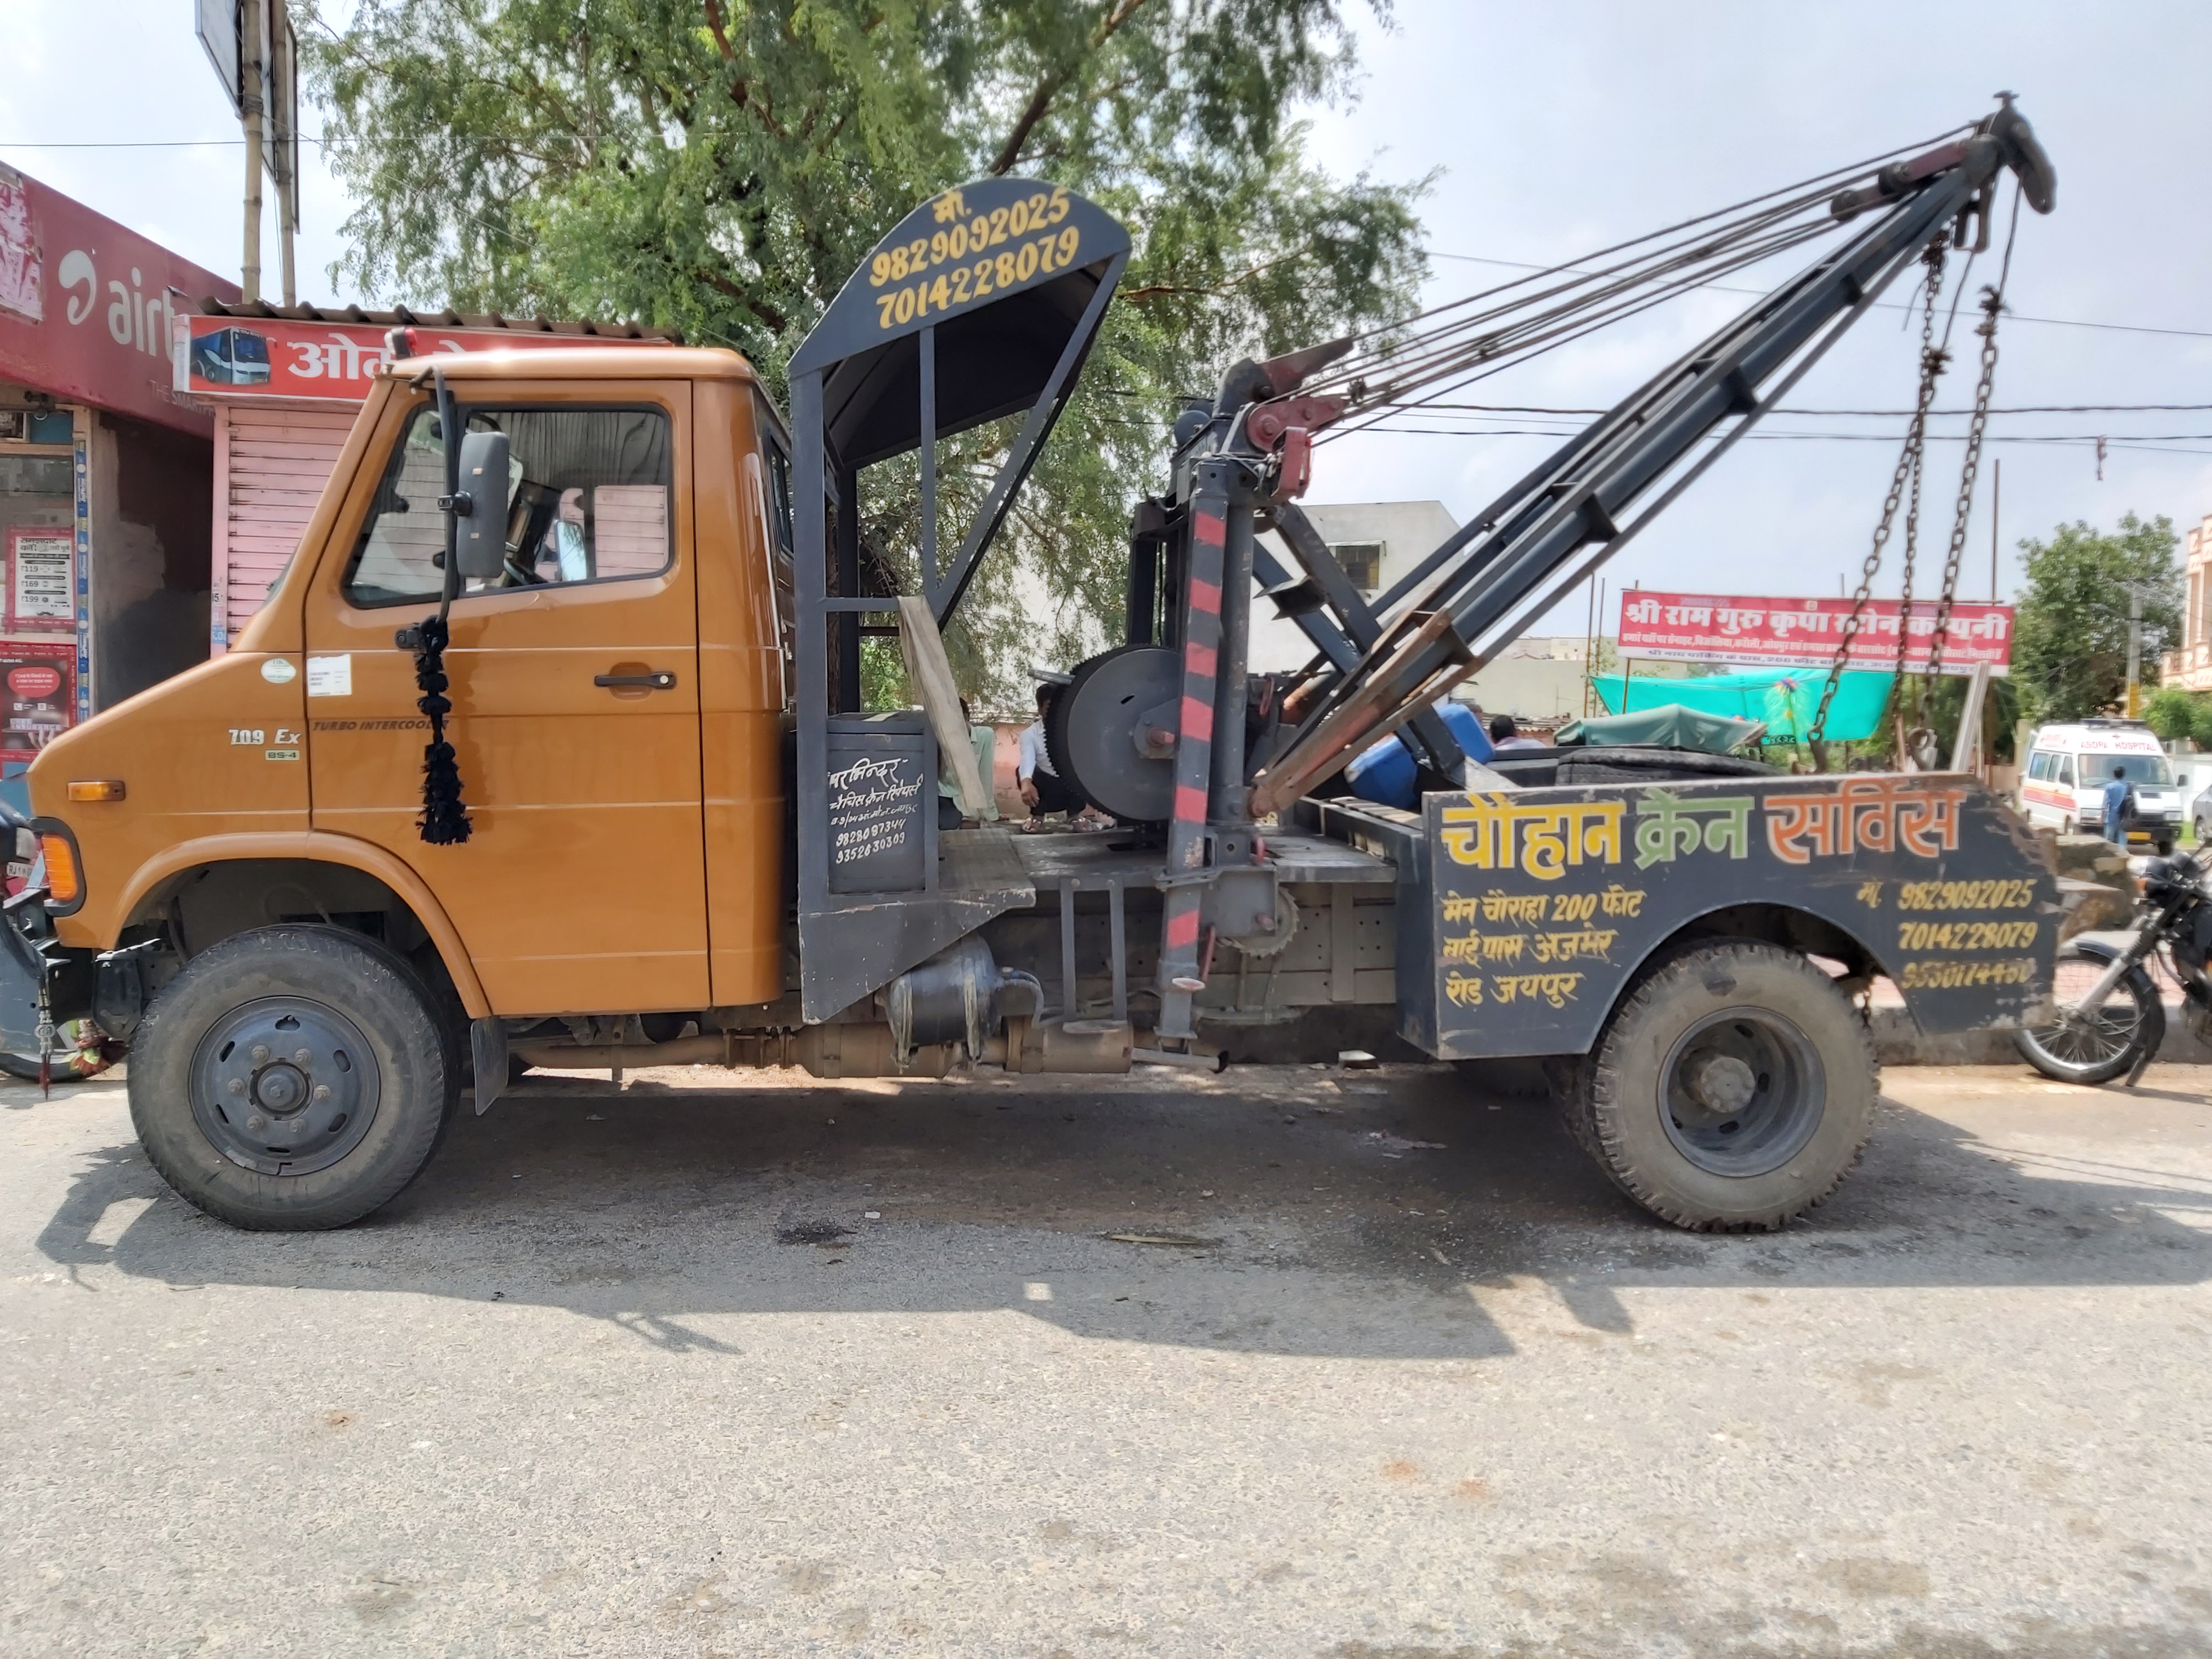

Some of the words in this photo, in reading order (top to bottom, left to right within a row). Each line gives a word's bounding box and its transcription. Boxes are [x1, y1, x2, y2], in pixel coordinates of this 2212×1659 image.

[869, 188, 1070, 287] 9829092025
[876, 225, 1079, 329] 7014228079
[1624, 599, 1662, 624] श्री
[1664, 605, 1714, 627] राम
[1716, 607, 1767, 635] गुरु
[1769, 610, 1832, 637] कृपा
[228, 729, 264, 745] 709
[274, 729, 301, 744] Ex
[313, 721, 357, 731] TURBO
[359, 720, 449, 731] INTERCOOLR
[2115, 742, 2157, 751] HOSPITAL
[1441, 791, 1627, 881] चौहान
[1440, 889, 1480, 926] मेन
[1480, 888, 1550, 929] चौराहा
[1551, 894, 1598, 922] 200
[1897, 878, 2038, 910] 9829092025
[1898, 921, 2039, 951] 7014228079
[1445, 970, 1484, 1008] रोड
[1490, 972, 1587, 1009] जयपुर
